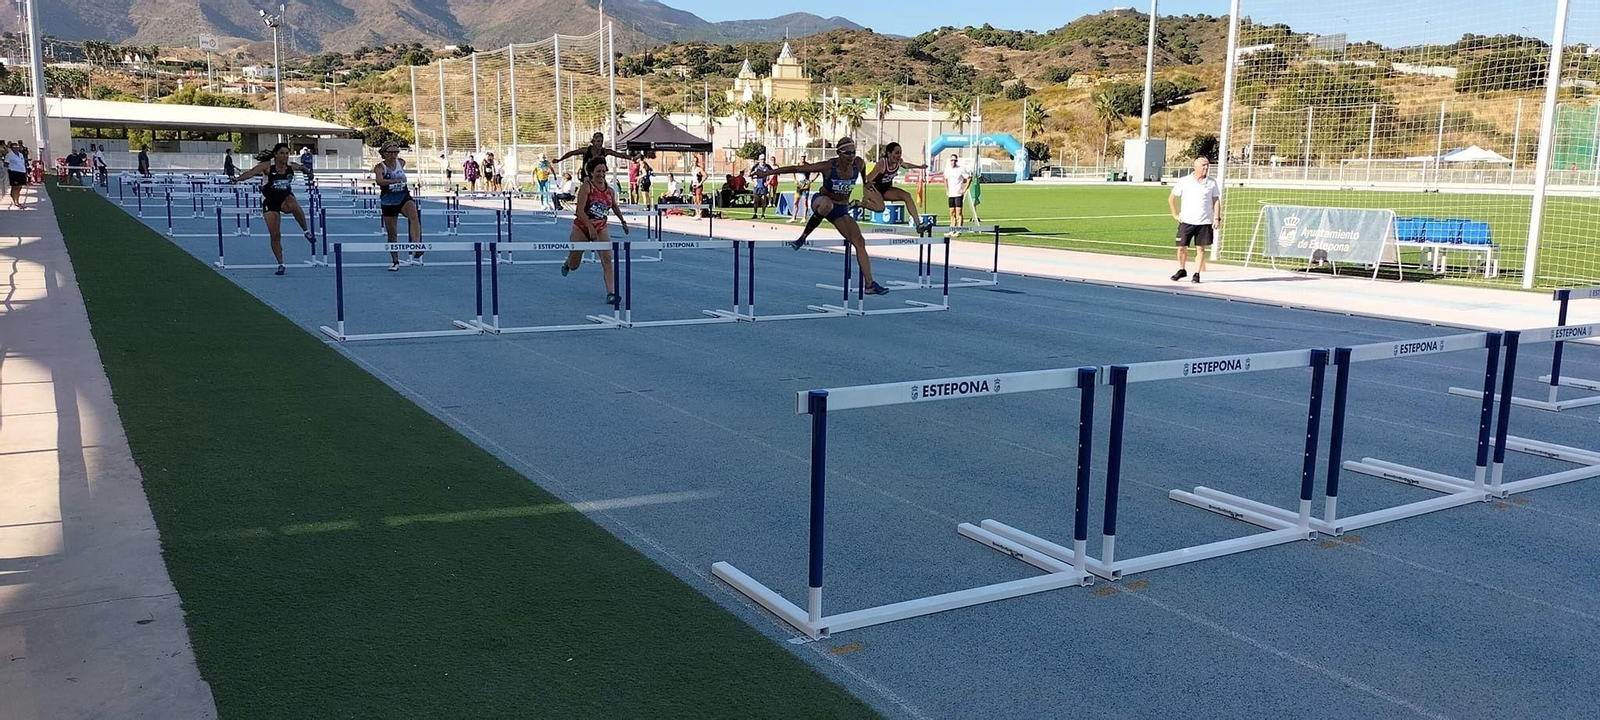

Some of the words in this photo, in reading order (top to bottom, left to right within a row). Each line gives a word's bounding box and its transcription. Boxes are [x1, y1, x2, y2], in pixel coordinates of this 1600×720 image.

[857, 207, 864, 219] 2
[895, 207, 902, 222] 1
[1300, 227, 1360, 240] Ayuntamiento
[1297, 239, 1309, 249] de
[1308, 239, 1350, 253] Estepona
[1555, 327, 1587, 338] ESTEPONA
[1399, 341, 1438, 354] ESTEPONA
[1191, 359, 1243, 374] ESTEPONA
[922, 378, 990, 398] ESTEPONA
